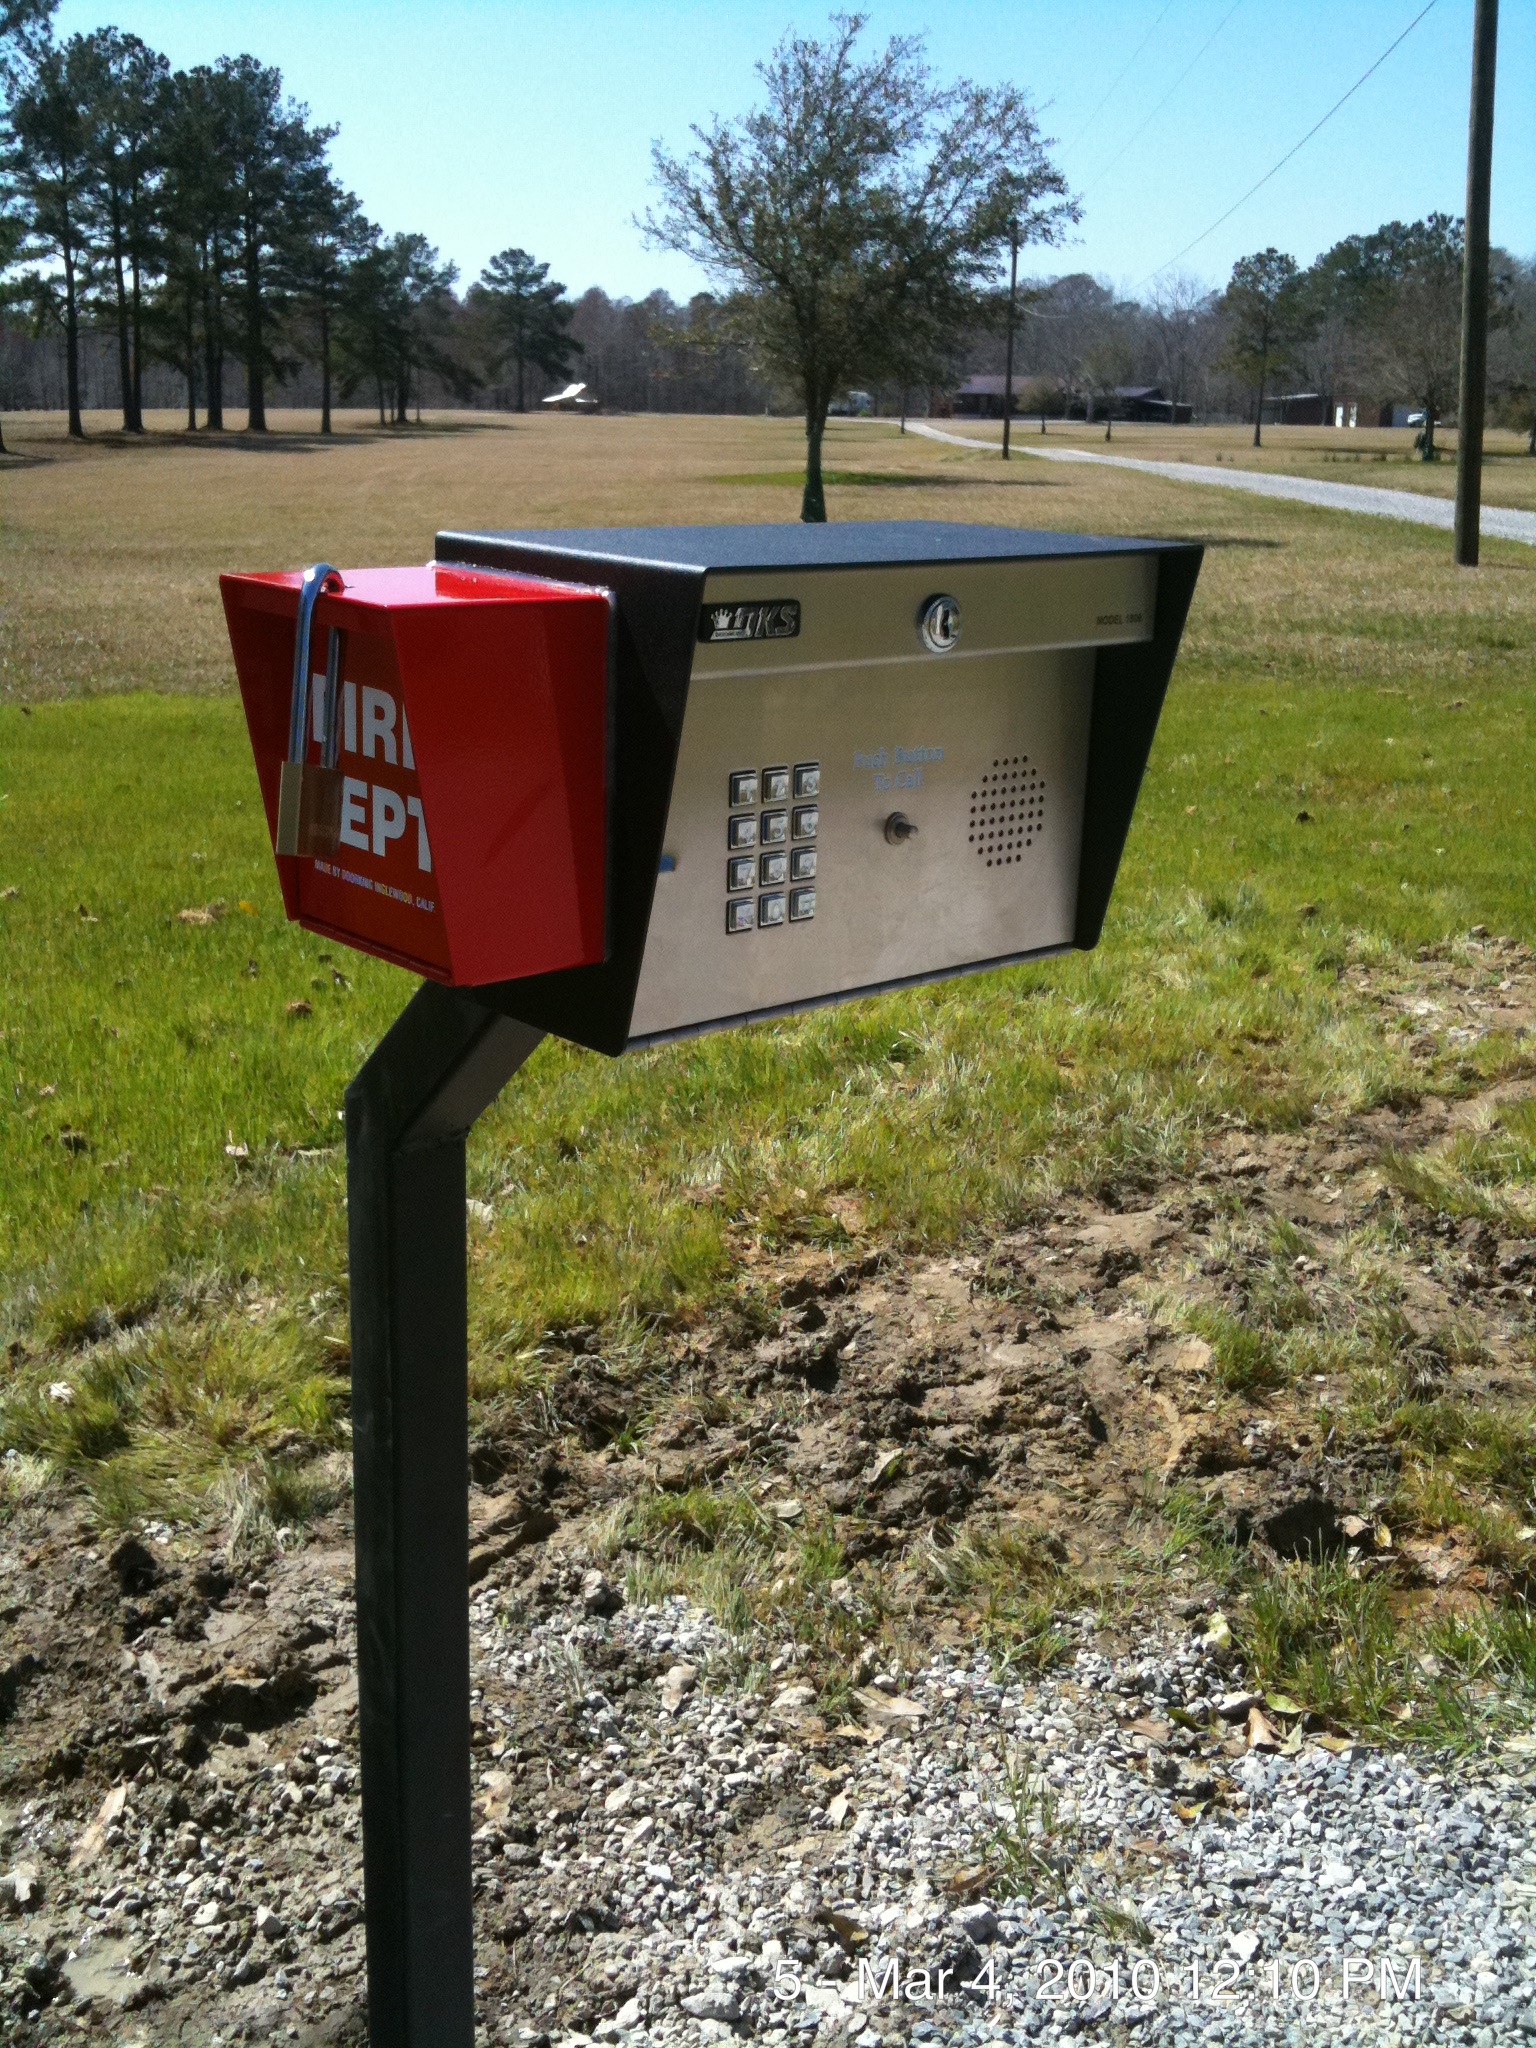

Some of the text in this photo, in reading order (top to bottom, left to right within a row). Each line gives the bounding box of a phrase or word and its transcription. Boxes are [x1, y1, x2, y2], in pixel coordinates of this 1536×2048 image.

[852, 746, 944, 770] Push Button
[874, 768, 923, 792] To Call
[340, 776, 431, 872] EPT
[315, 859, 331, 874] MADE
[332, 866, 340, 878] BY
